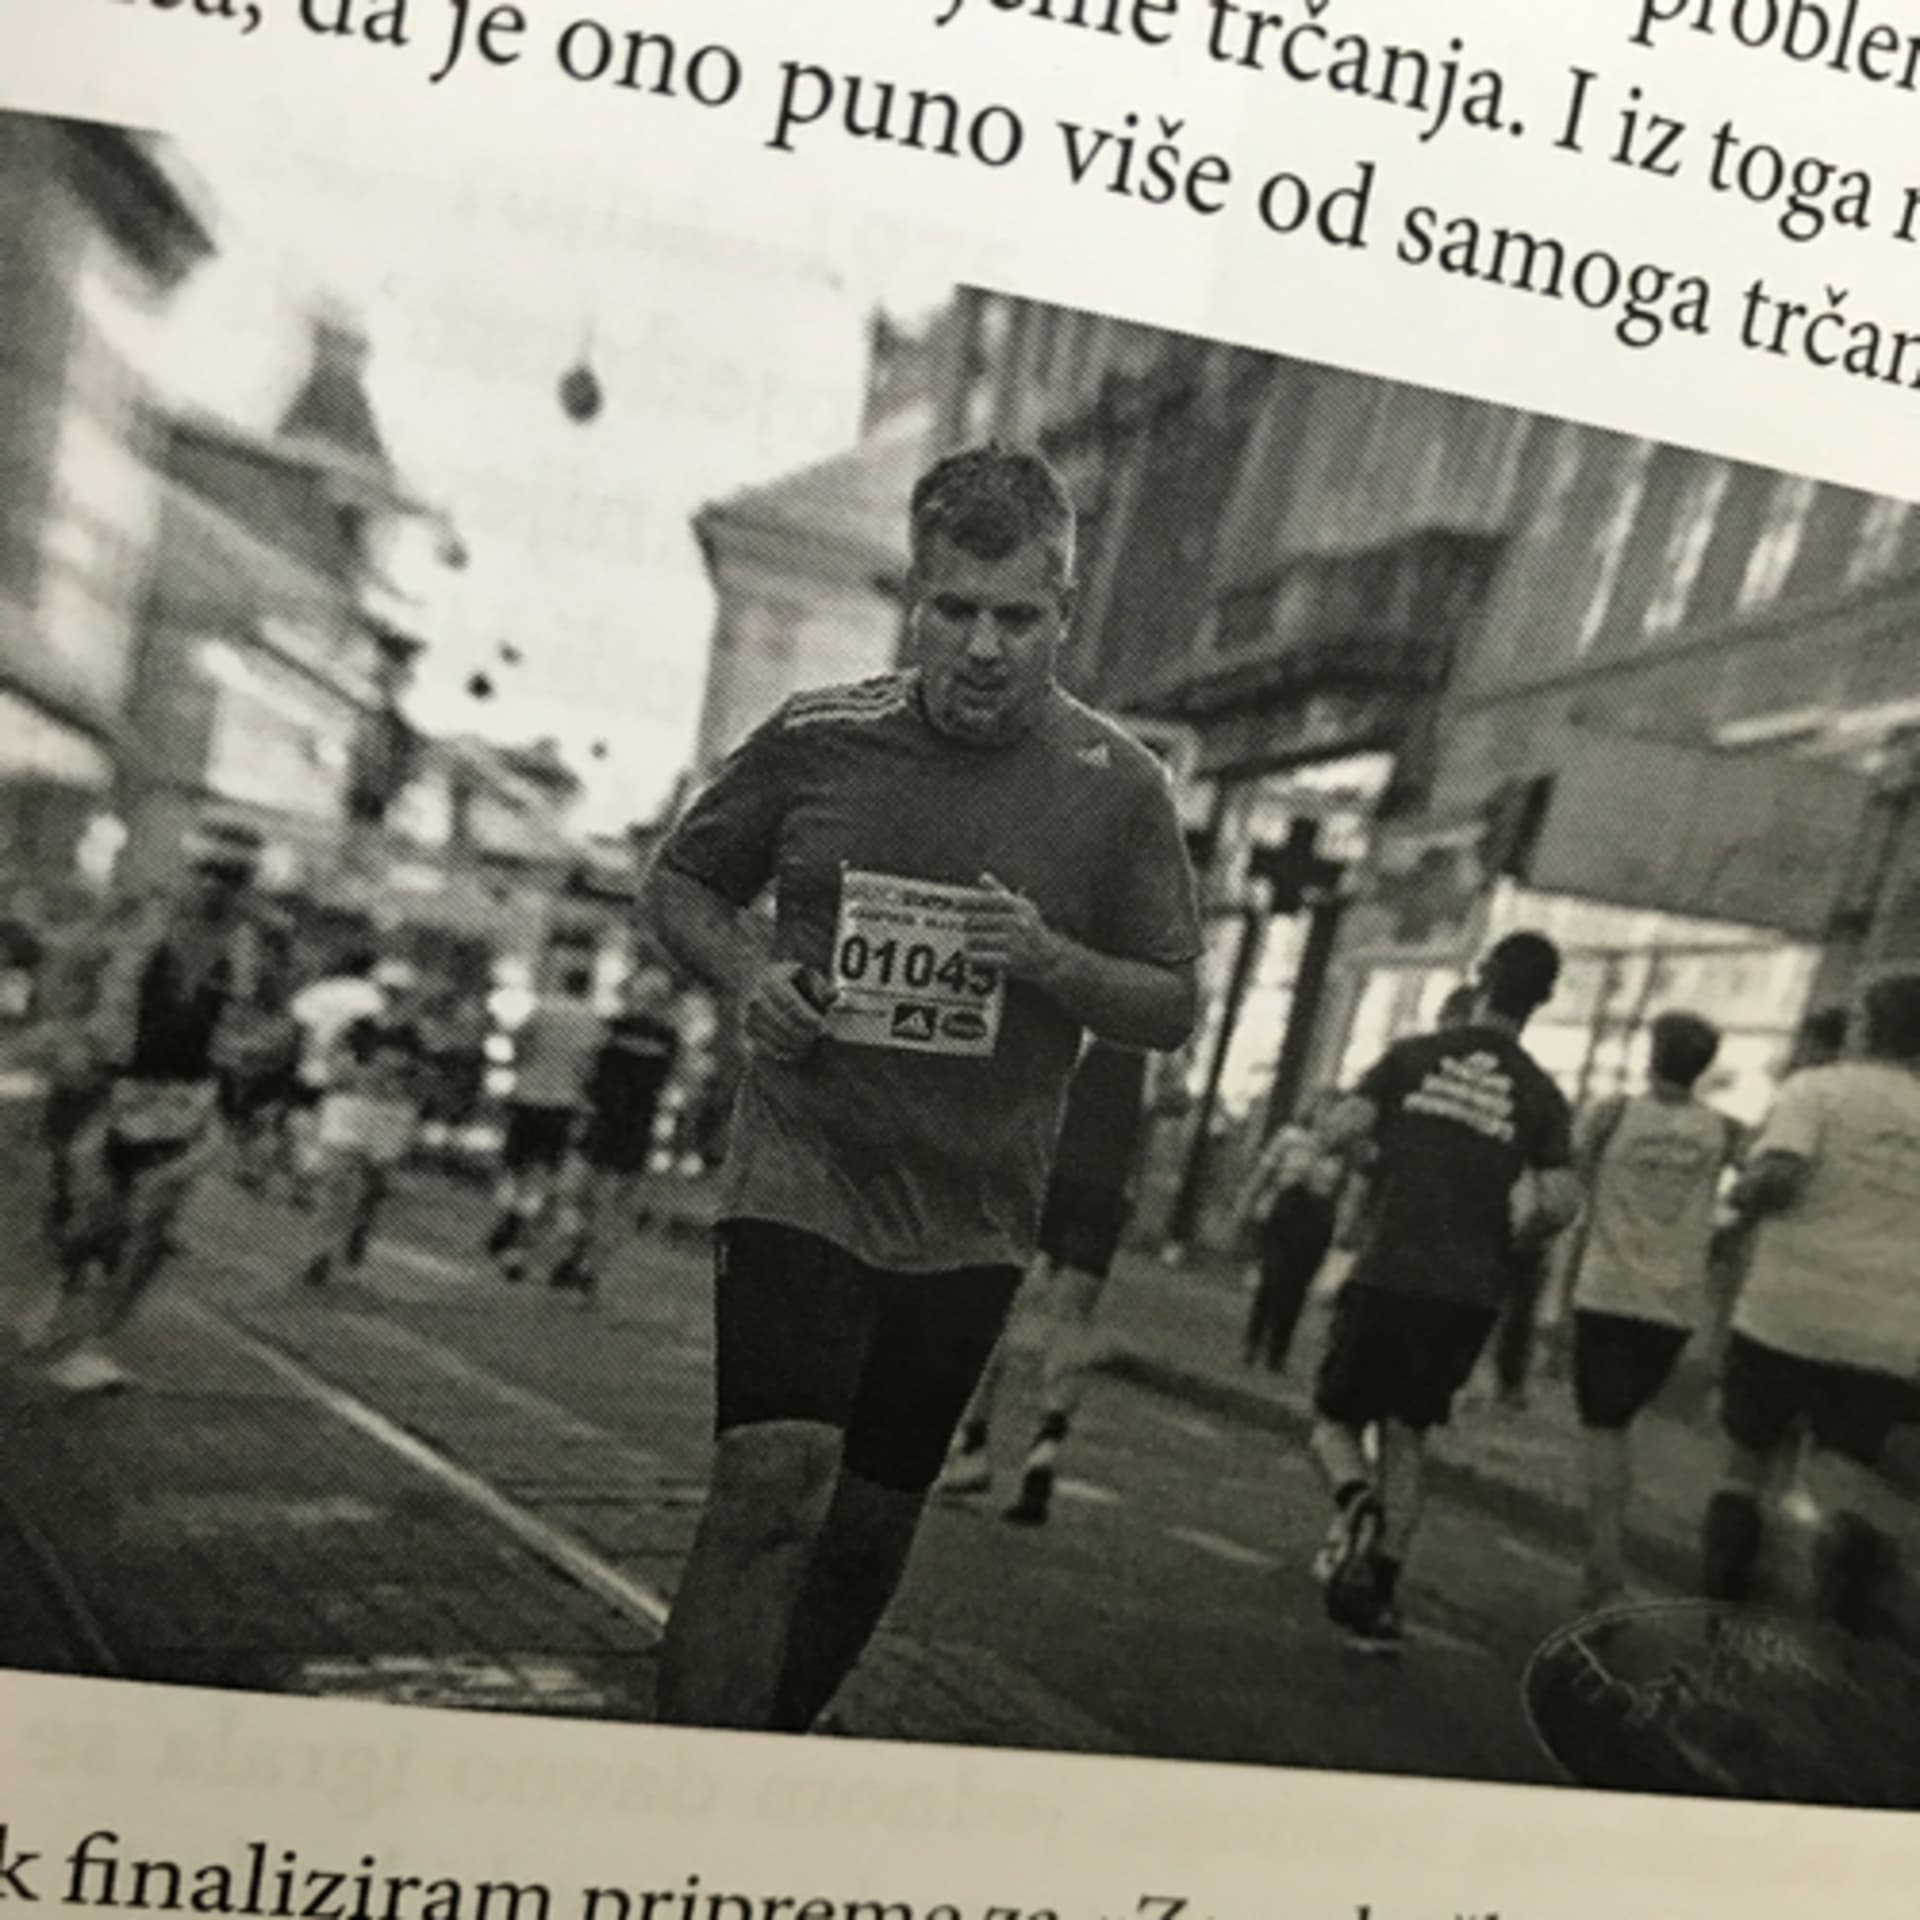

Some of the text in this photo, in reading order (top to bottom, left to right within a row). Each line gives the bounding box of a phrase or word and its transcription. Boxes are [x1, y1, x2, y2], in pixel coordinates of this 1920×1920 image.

[428, 0, 526, 84] je
[557, 21, 742, 106] ono
[766, 61, 1024, 167] puno
[1056, 113, 1232, 215] više
[1258, 162, 1375, 249] od
[1396, 206, 1710, 349] samoga
[1208, 0, 1524, 142] trčanja.
[1555, 68, 1597, 151] I
[1611, 86, 1686, 177] iz
[1709, 121, 1872, 243] toga
[61, 1830, 551, 1920] finaliziram
